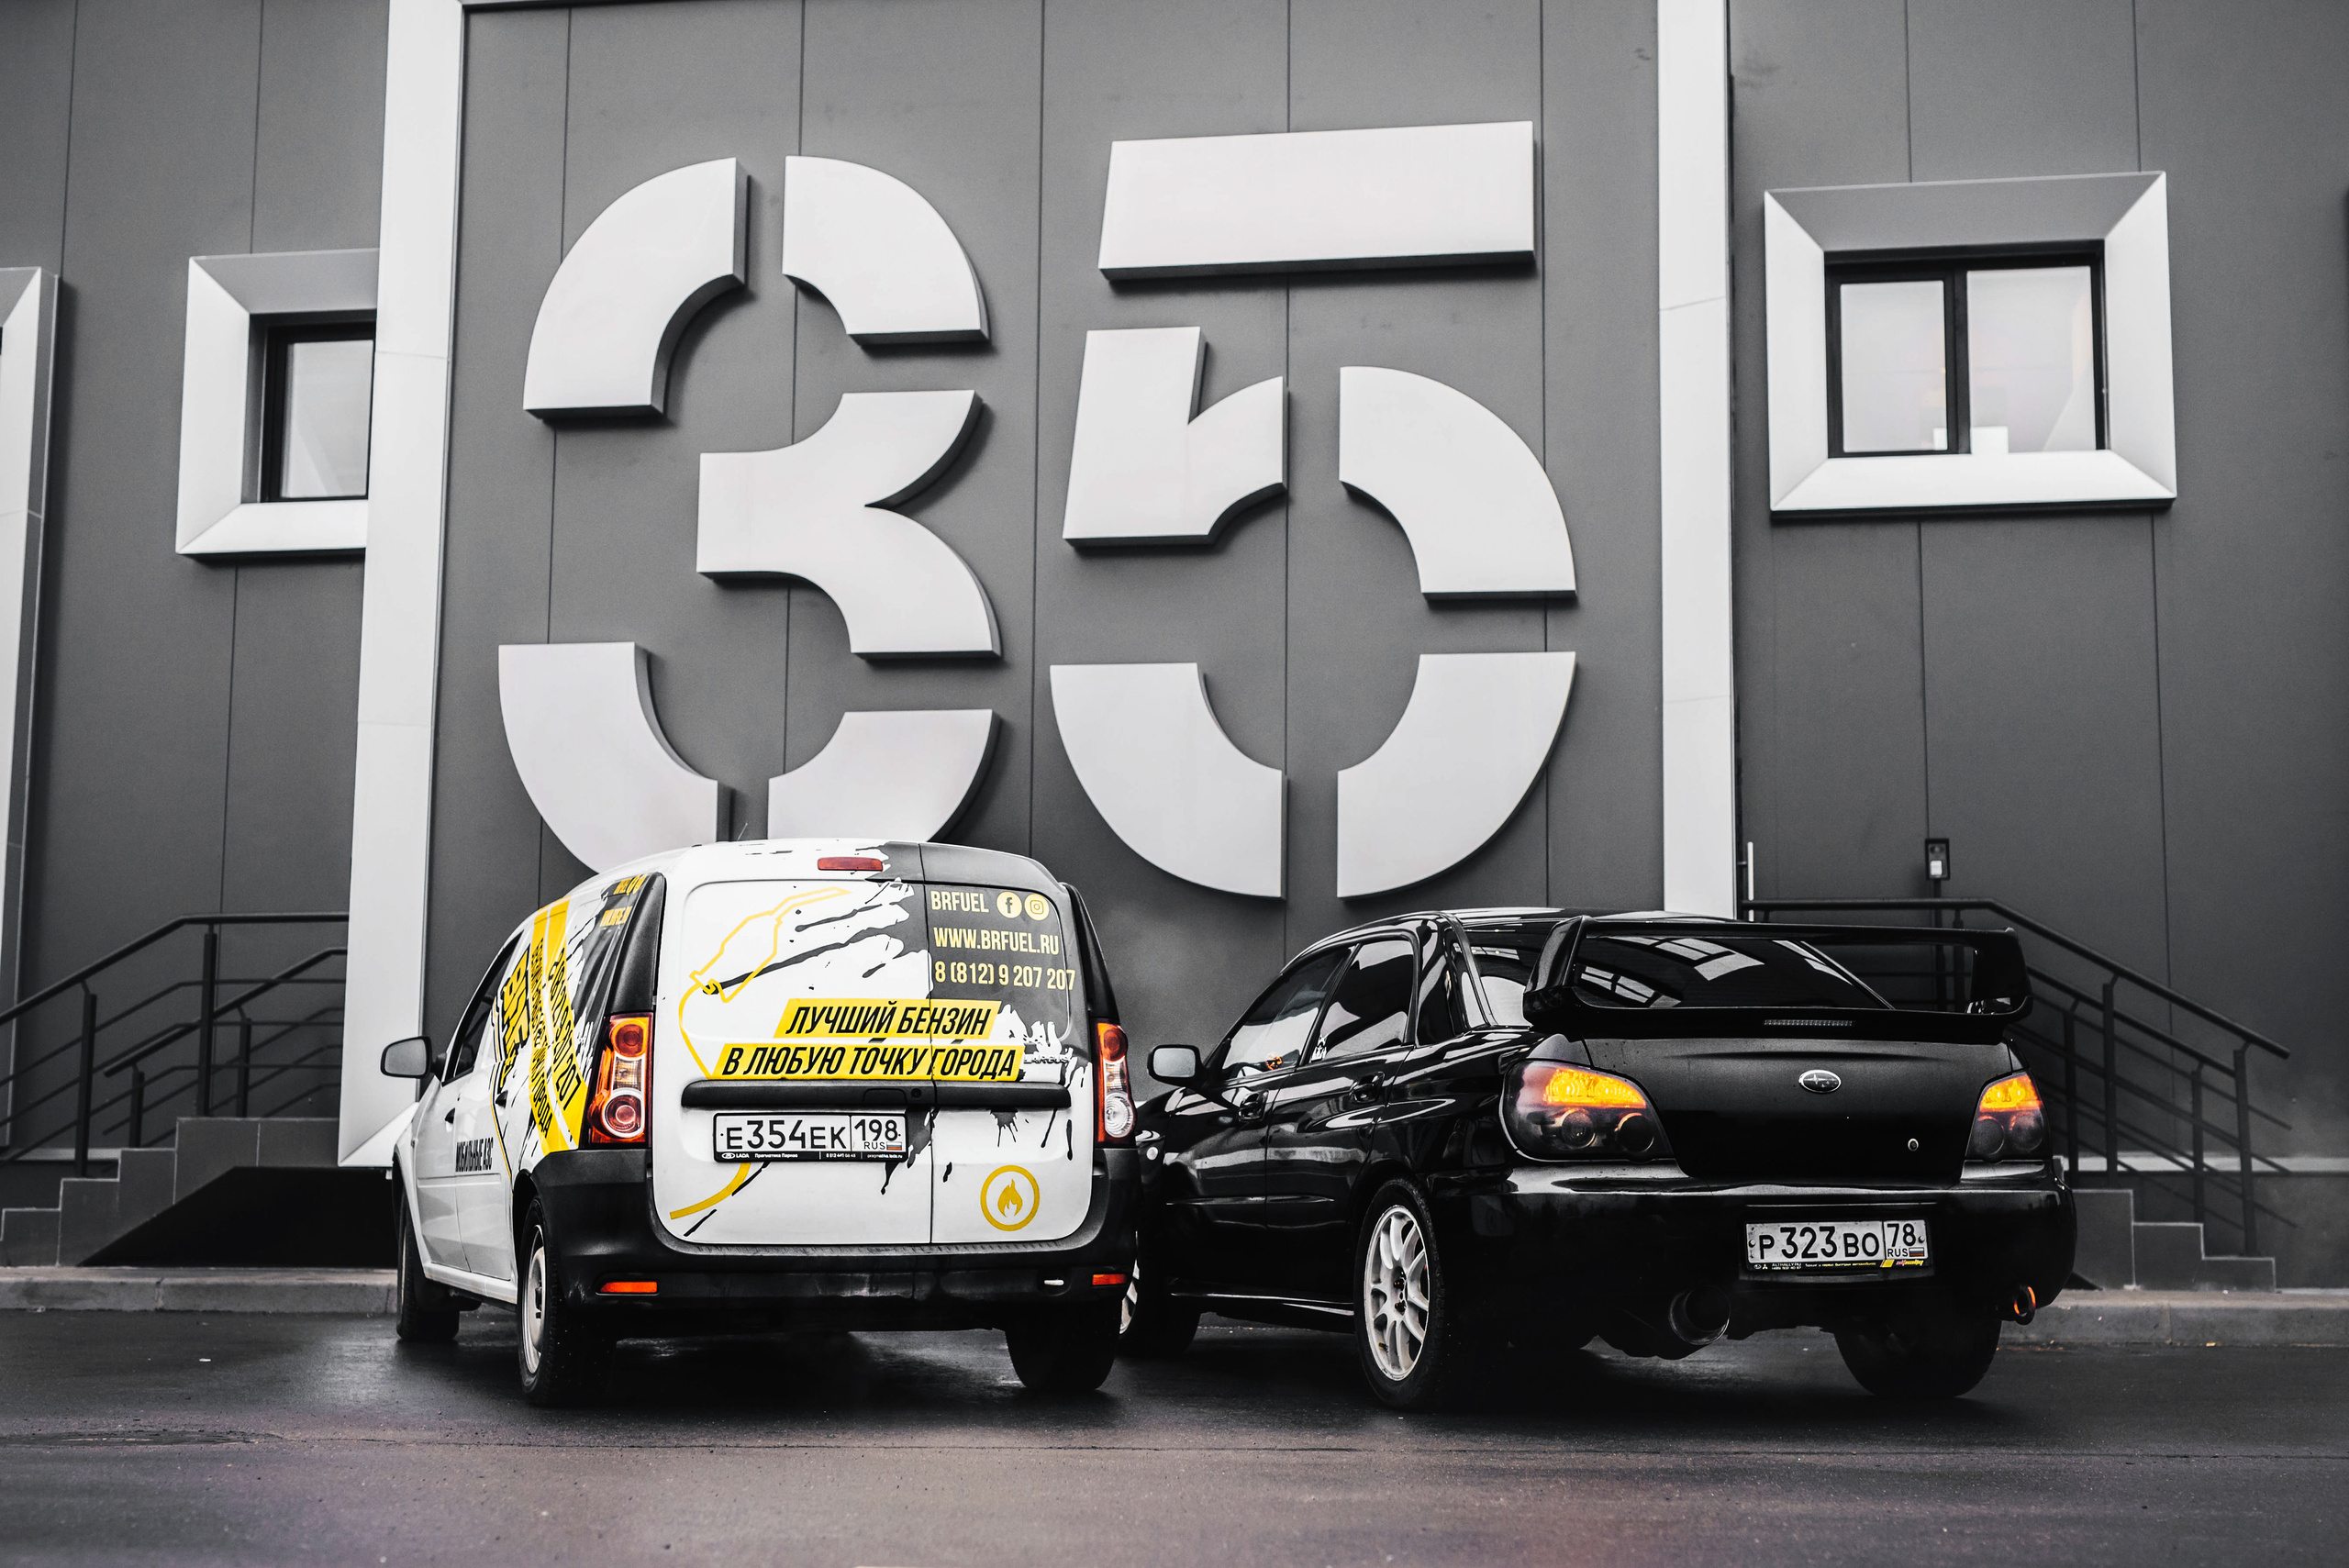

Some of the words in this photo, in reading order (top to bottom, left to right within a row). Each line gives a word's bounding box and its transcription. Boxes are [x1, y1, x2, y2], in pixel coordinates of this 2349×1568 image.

[498, 120, 1576, 899] 35
[930, 890, 989, 913] BRFUEL
[933, 927, 1059, 955] WWW.BRFUEL.RU
[934, 961, 946, 983] 8
[951, 962, 995, 984] (812)
[998, 964, 1009, 985] 9
[1013, 965, 1042, 988] 207
[1047, 968, 1076, 991] 207
[785, 1000, 897, 1035] ЛУЧШИЙ
[896, 1006, 992, 1036] БЕНЗИН
[722, 1048, 743, 1075] В
[743, 1047, 846, 1076] ЛЮБУЮ
[852, 1047, 929, 1077] ТОЧКУ
[931, 1048, 1016, 1080] ГОРОДА
[556, 1052, 582, 1111] 207
[854, 1118, 898, 1141] 198
[863, 1141, 885, 1151] RUS
[1887, 1223, 1916, 1247] 78
[1887, 1248, 1909, 1258] RUS
